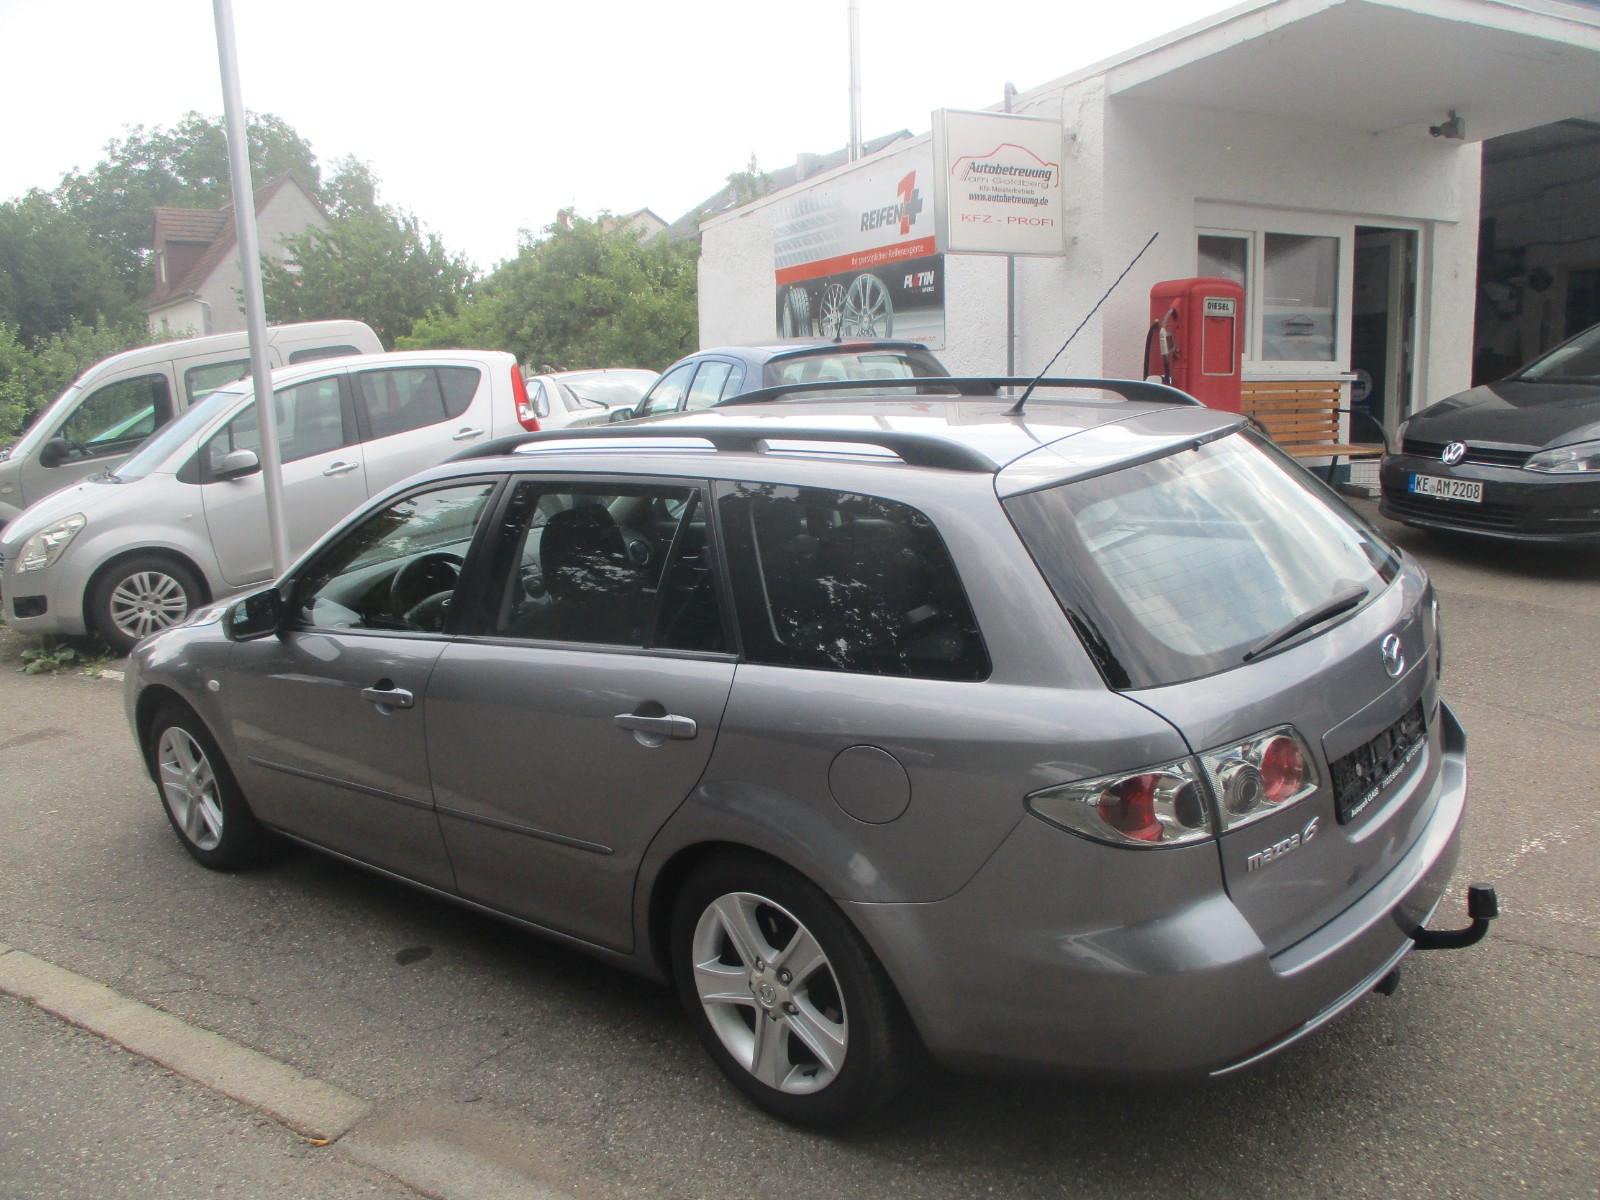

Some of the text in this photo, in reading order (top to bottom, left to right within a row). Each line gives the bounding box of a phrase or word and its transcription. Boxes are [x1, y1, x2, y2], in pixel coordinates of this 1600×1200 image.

[969, 161, 1052, 181] Autobetreuung
[967, 176, 1049, 190] am Goldberg
[968, 192, 1049, 207] www.autobetreuung.de
[860, 203, 904, 232] REIFEN
[961, 213, 993, 224] KFZ
[1007, 216, 1054, 227] PROFI
[1207, 302, 1230, 311] DIESEL
[1415, 476, 1480, 499] KE AM 2208
